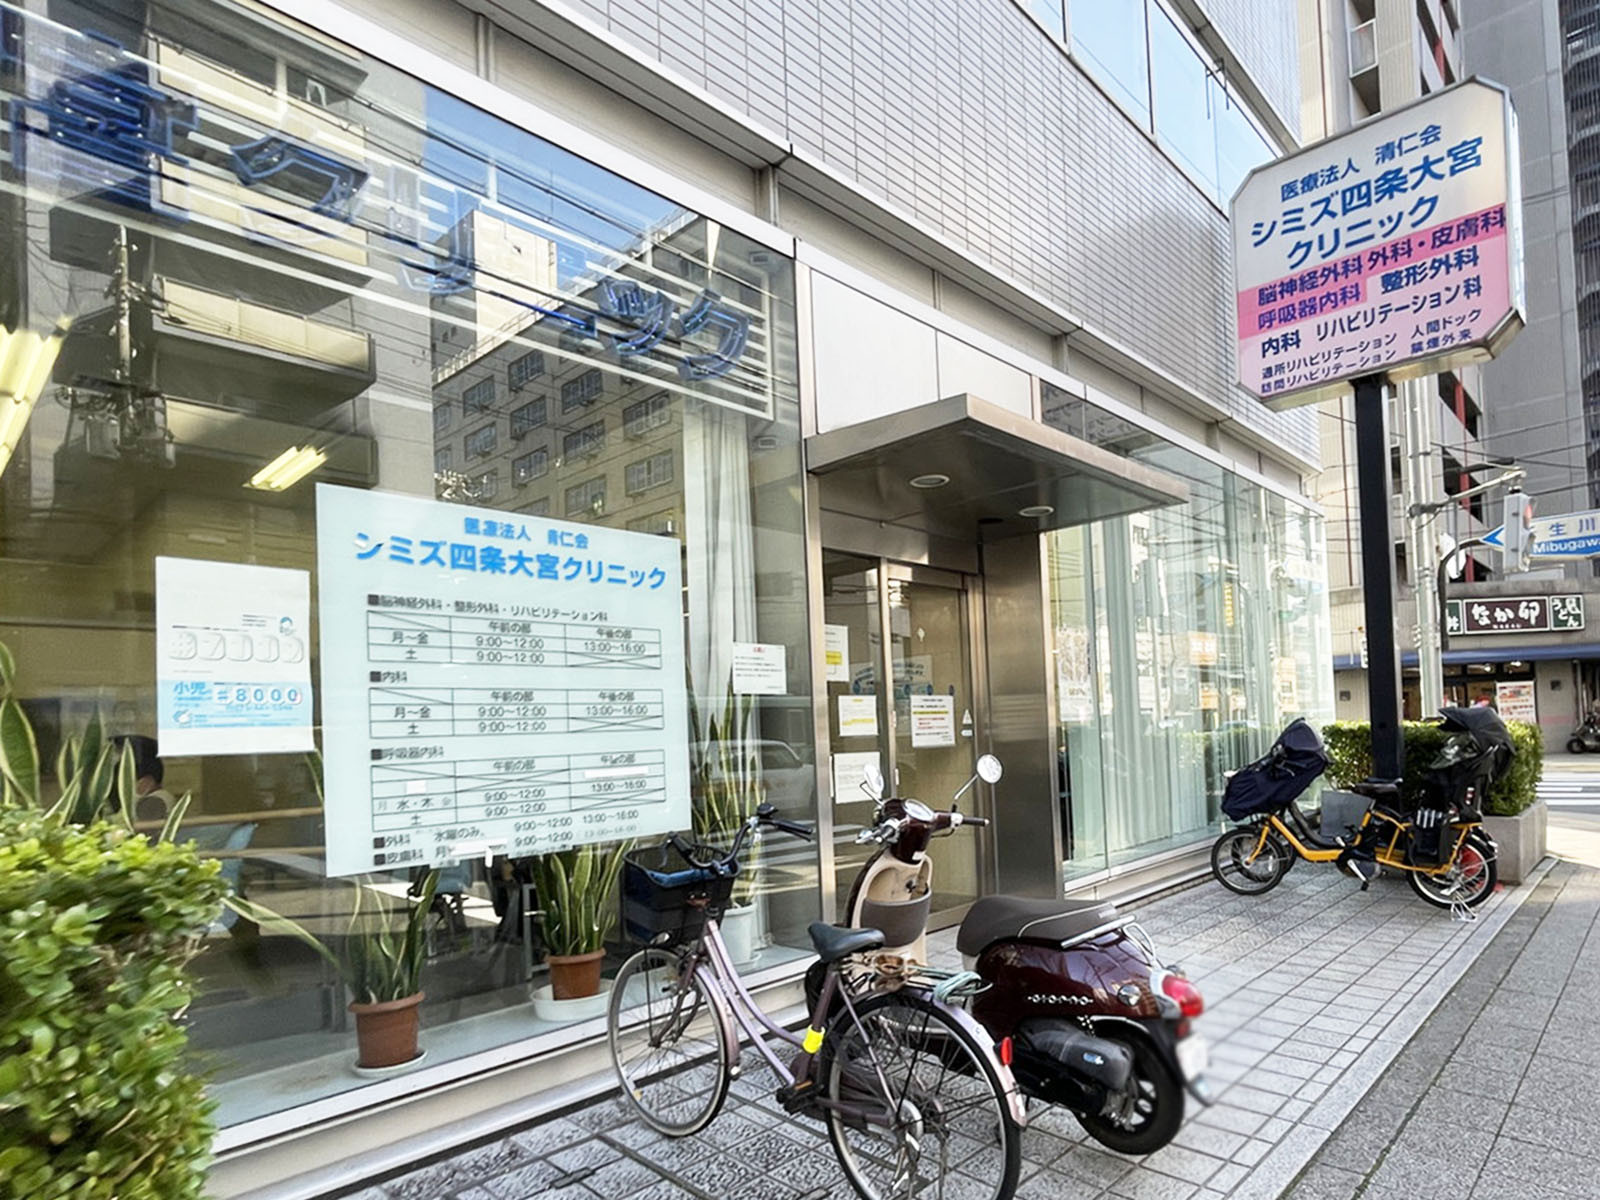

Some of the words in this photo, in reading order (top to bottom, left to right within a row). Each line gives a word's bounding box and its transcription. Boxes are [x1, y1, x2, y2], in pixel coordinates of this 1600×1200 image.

[1252, 137, 1483, 247] シミズ四条大宮
[1281, 158, 1360, 202] 医療法人
[1375, 124, 1441, 165] 清仁会
[1258, 255, 1363, 306] 脳神経外科
[1368, 207, 1506, 270] 外科・皮膚科
[1287, 195, 1439, 270] クリニック
[1258, 282, 1362, 330] 呼吸器内科
[1381, 245, 1480, 295] 整形外科
[1261, 330, 1302, 359] 内科
[1317, 275, 1482, 341] リハビリテーション科
[355, 532, 666, 589] シミズ四条大宮クリニック
[1533, 537, 1600, 553] Mibugaw
[1471, 601, 1540, 626] なか卯
